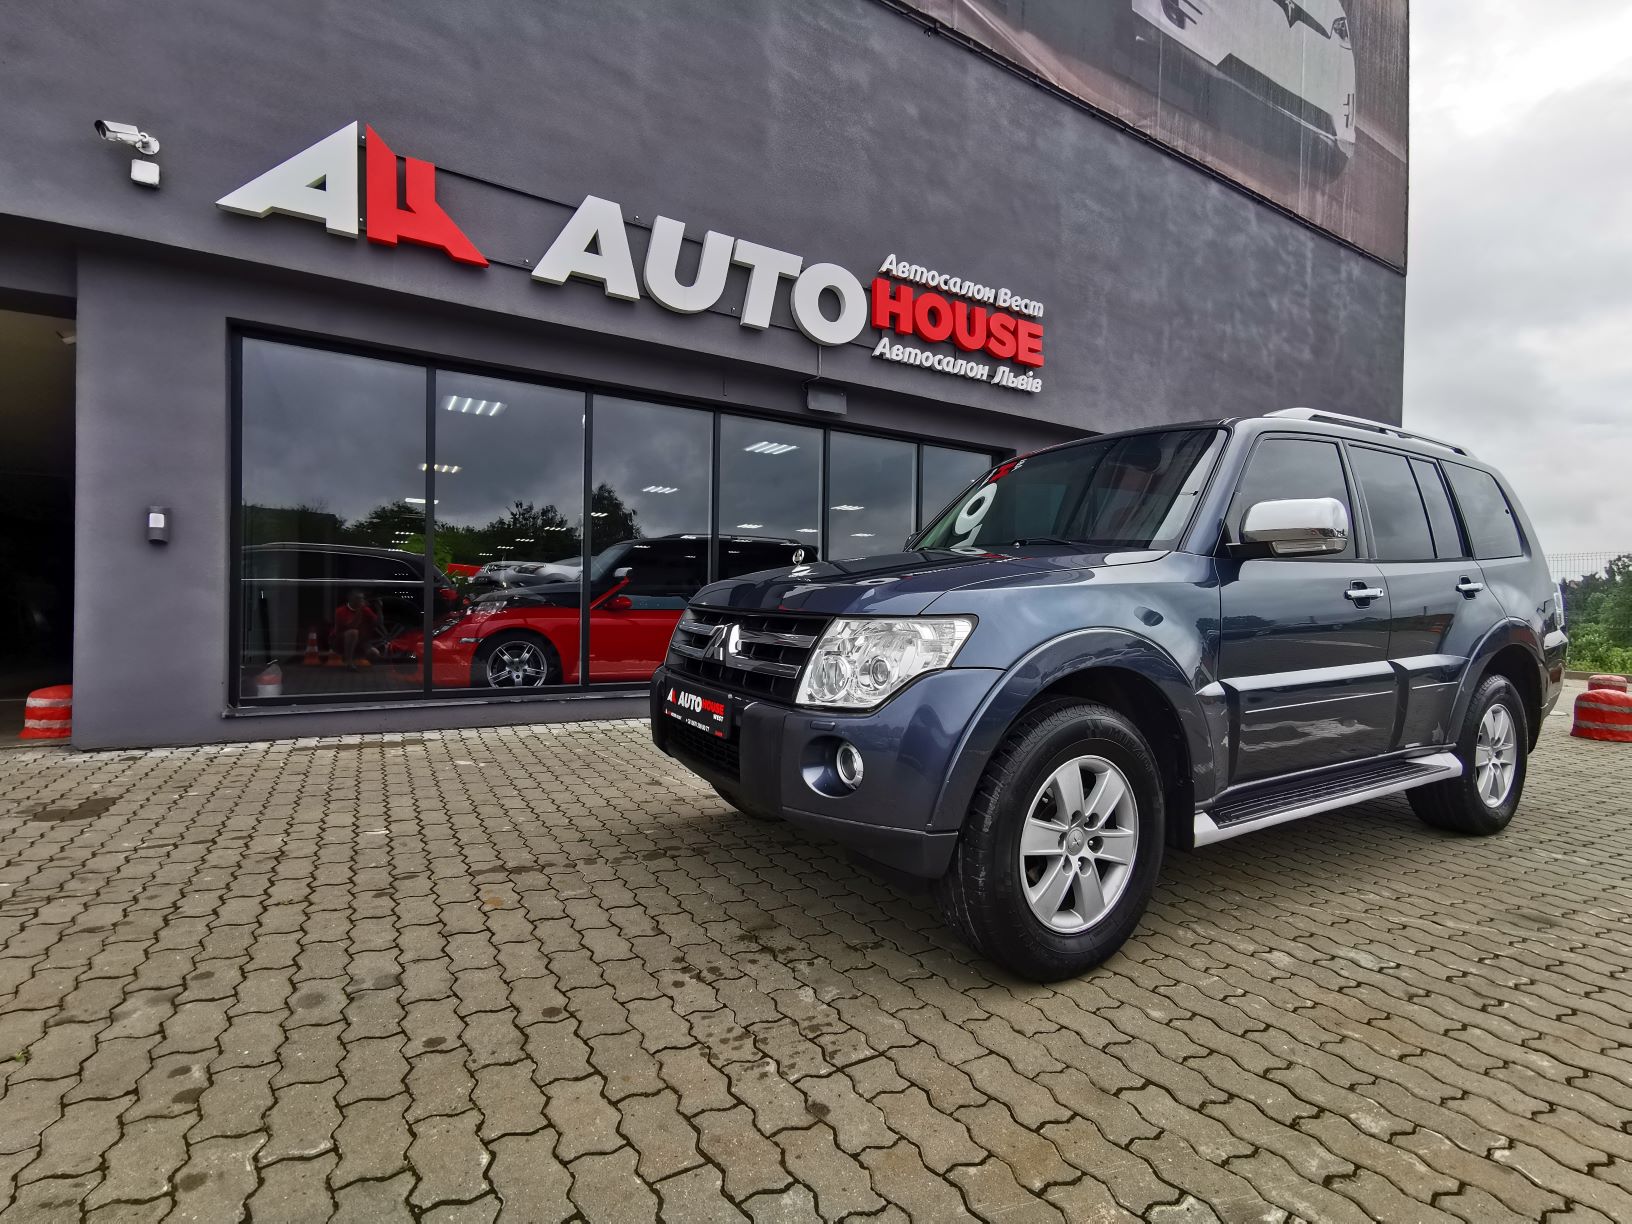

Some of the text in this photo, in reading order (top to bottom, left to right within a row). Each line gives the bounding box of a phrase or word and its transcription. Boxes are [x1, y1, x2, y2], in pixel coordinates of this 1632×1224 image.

[878, 253, 1044, 318] Автосалон Вест
[871, 336, 1043, 394] Автосалон Львів
